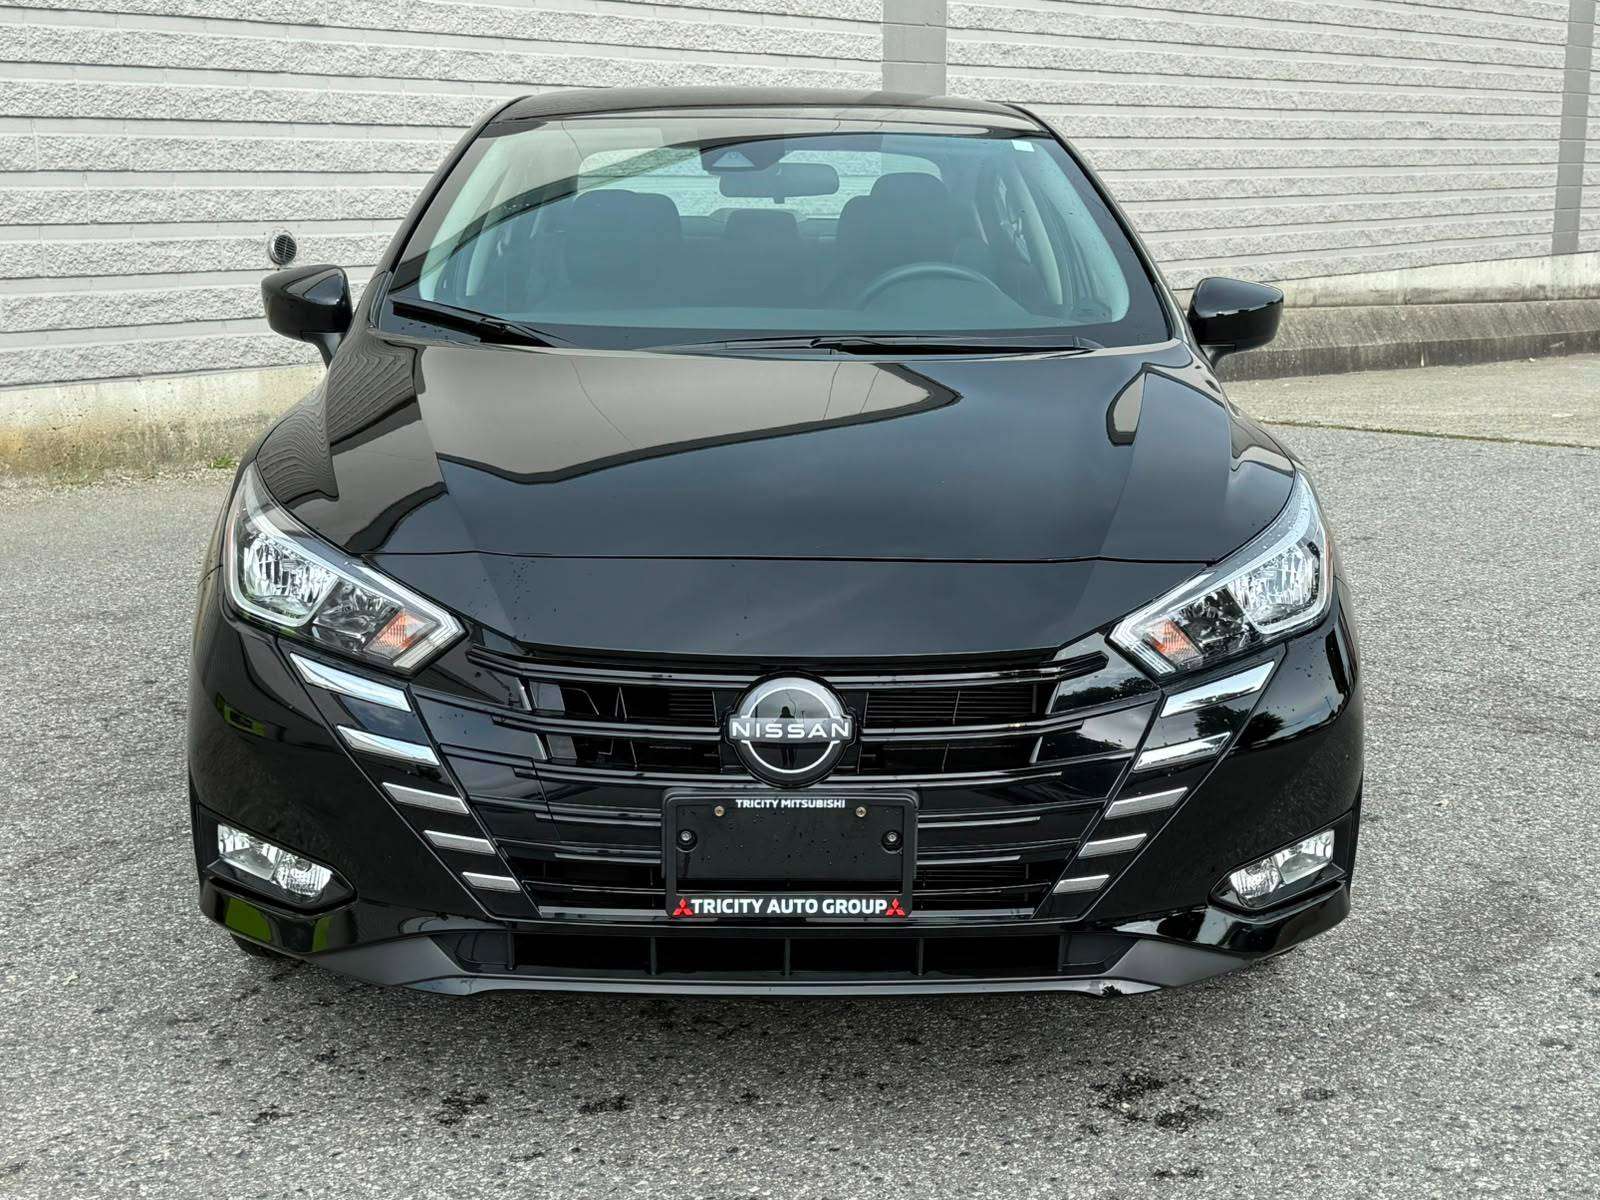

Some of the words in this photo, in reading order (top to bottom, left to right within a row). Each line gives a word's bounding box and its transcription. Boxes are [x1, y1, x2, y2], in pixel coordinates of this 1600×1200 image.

[731, 721, 849, 739] NISSAN
[735, 799, 778, 808] TRICITY
[781, 799, 846, 808] MITSUBISHI
[690, 899, 761, 914] TRICITY
[767, 899, 818, 914] AUTO
[822, 899, 888, 914] GROUP
